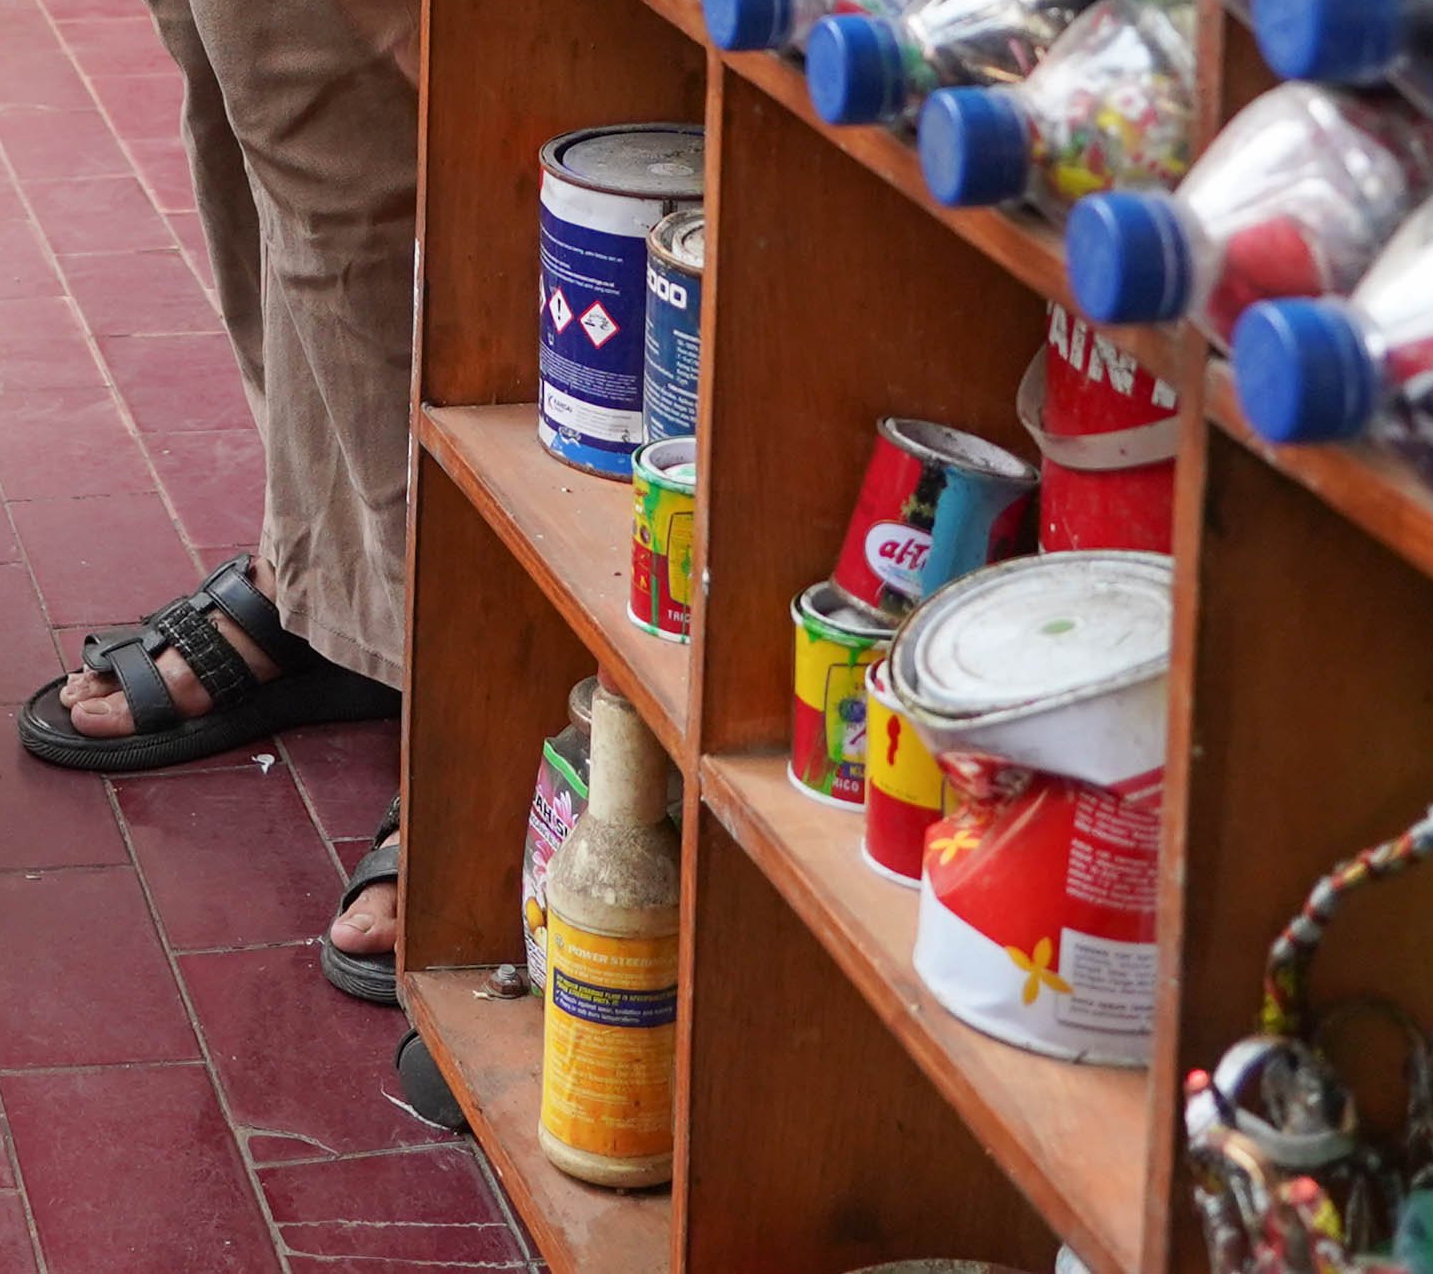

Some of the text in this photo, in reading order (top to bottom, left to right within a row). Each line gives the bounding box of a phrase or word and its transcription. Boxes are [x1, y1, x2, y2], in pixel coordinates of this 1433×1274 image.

[879, 538, 930, 571] al-T
[533, 794, 553, 824] AH
[568, 944, 607, 965] POWER
